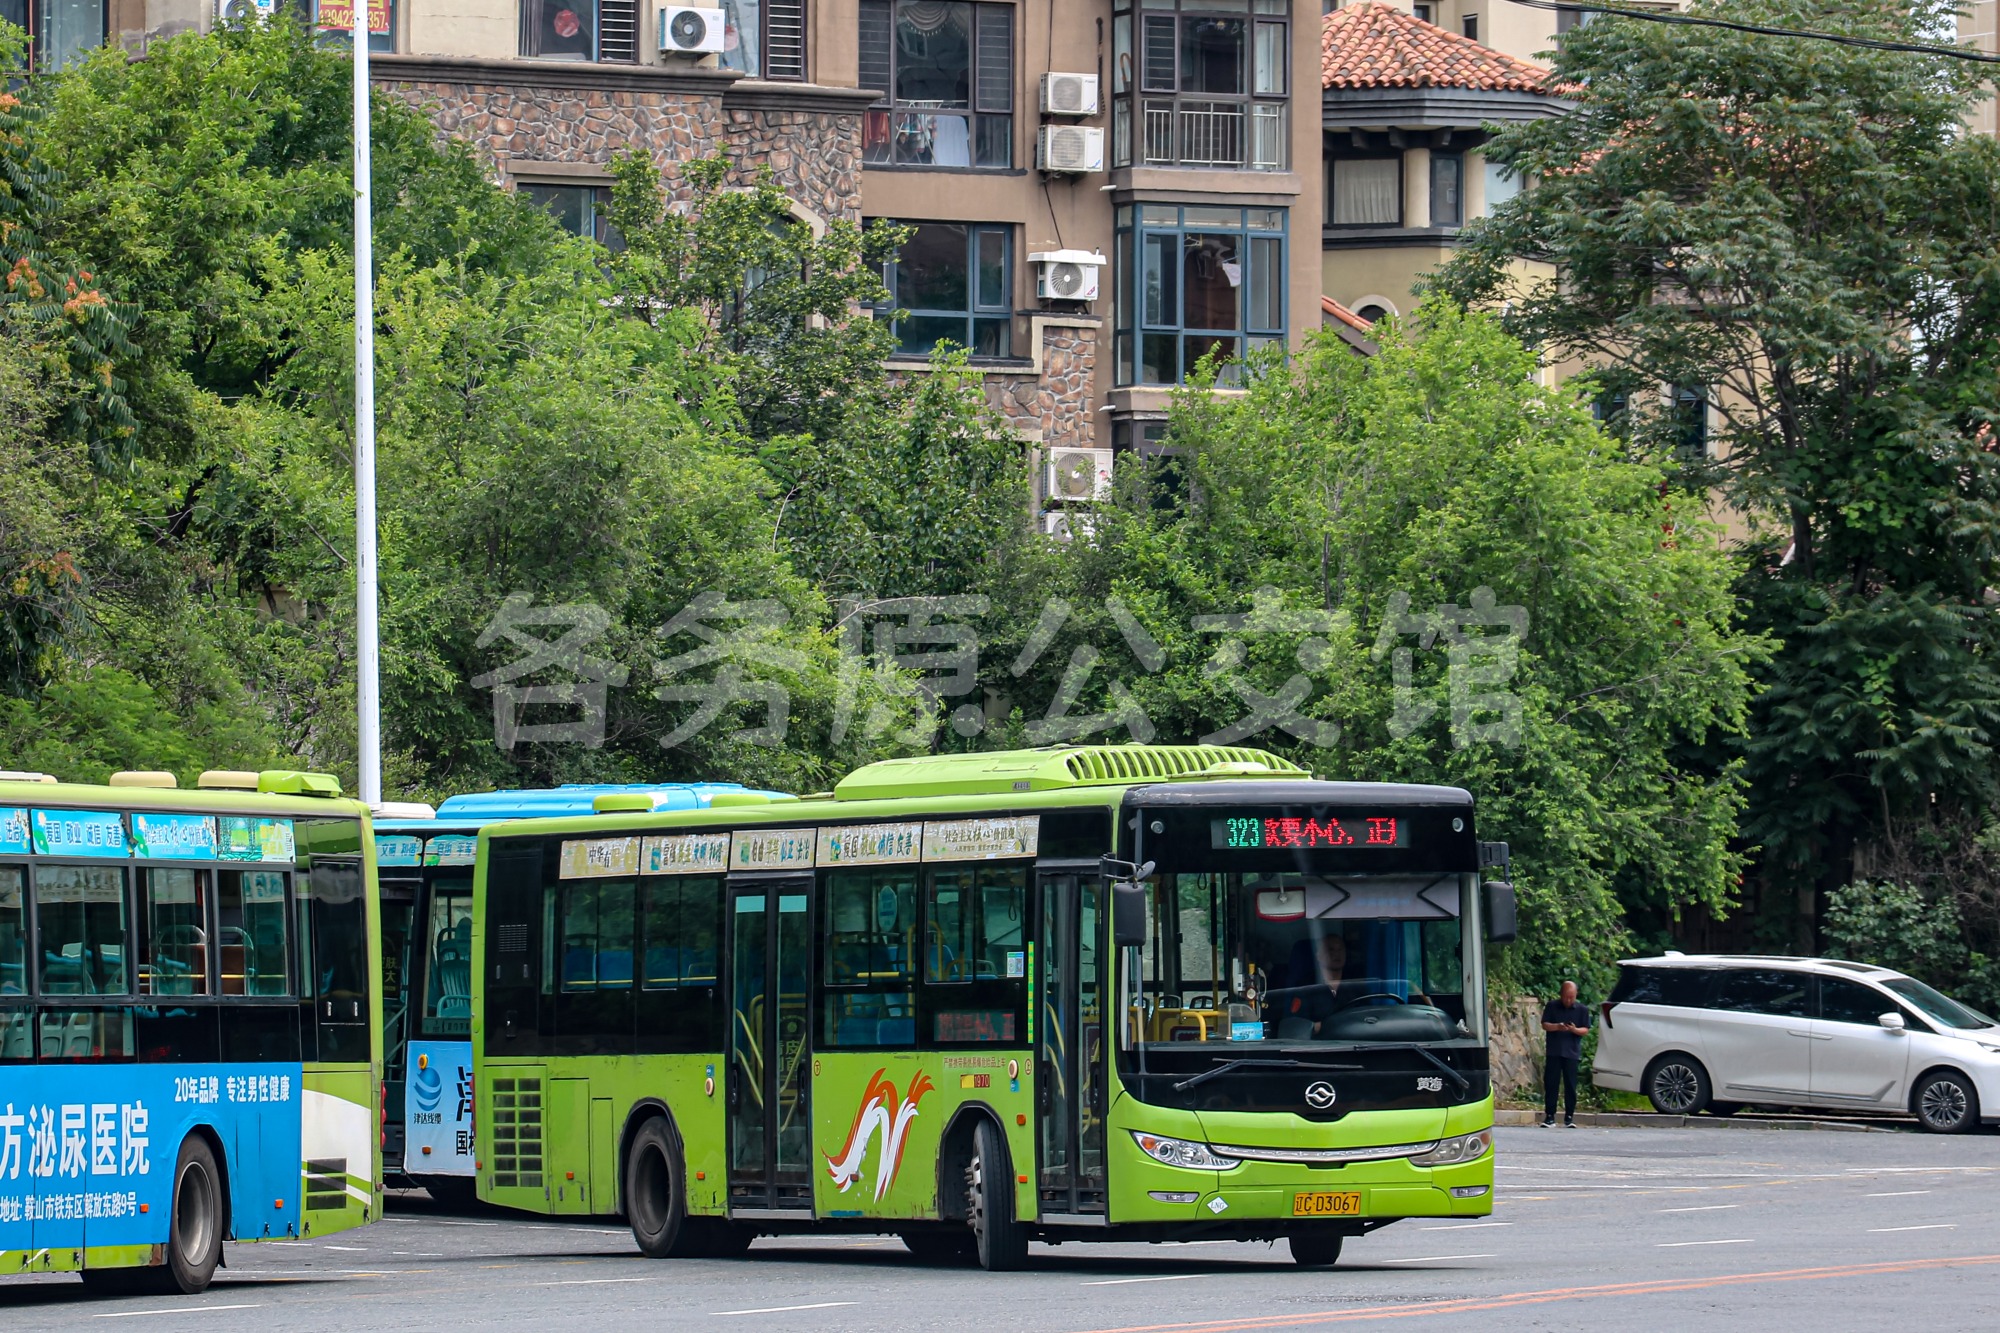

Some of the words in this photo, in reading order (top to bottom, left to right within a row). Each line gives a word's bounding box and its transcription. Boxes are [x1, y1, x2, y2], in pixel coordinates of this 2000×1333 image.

[1227, 818, 1260, 847] 323
[175, 1076, 218, 1103] 20年品牌
[226, 1075, 290, 1102] 专注男性健康
[413, 1113, 441, 1124] 津达线缆
[0, 1100, 149, 1179] 方泌尿医院
[1211, 1201, 1224, 1210] LNG
